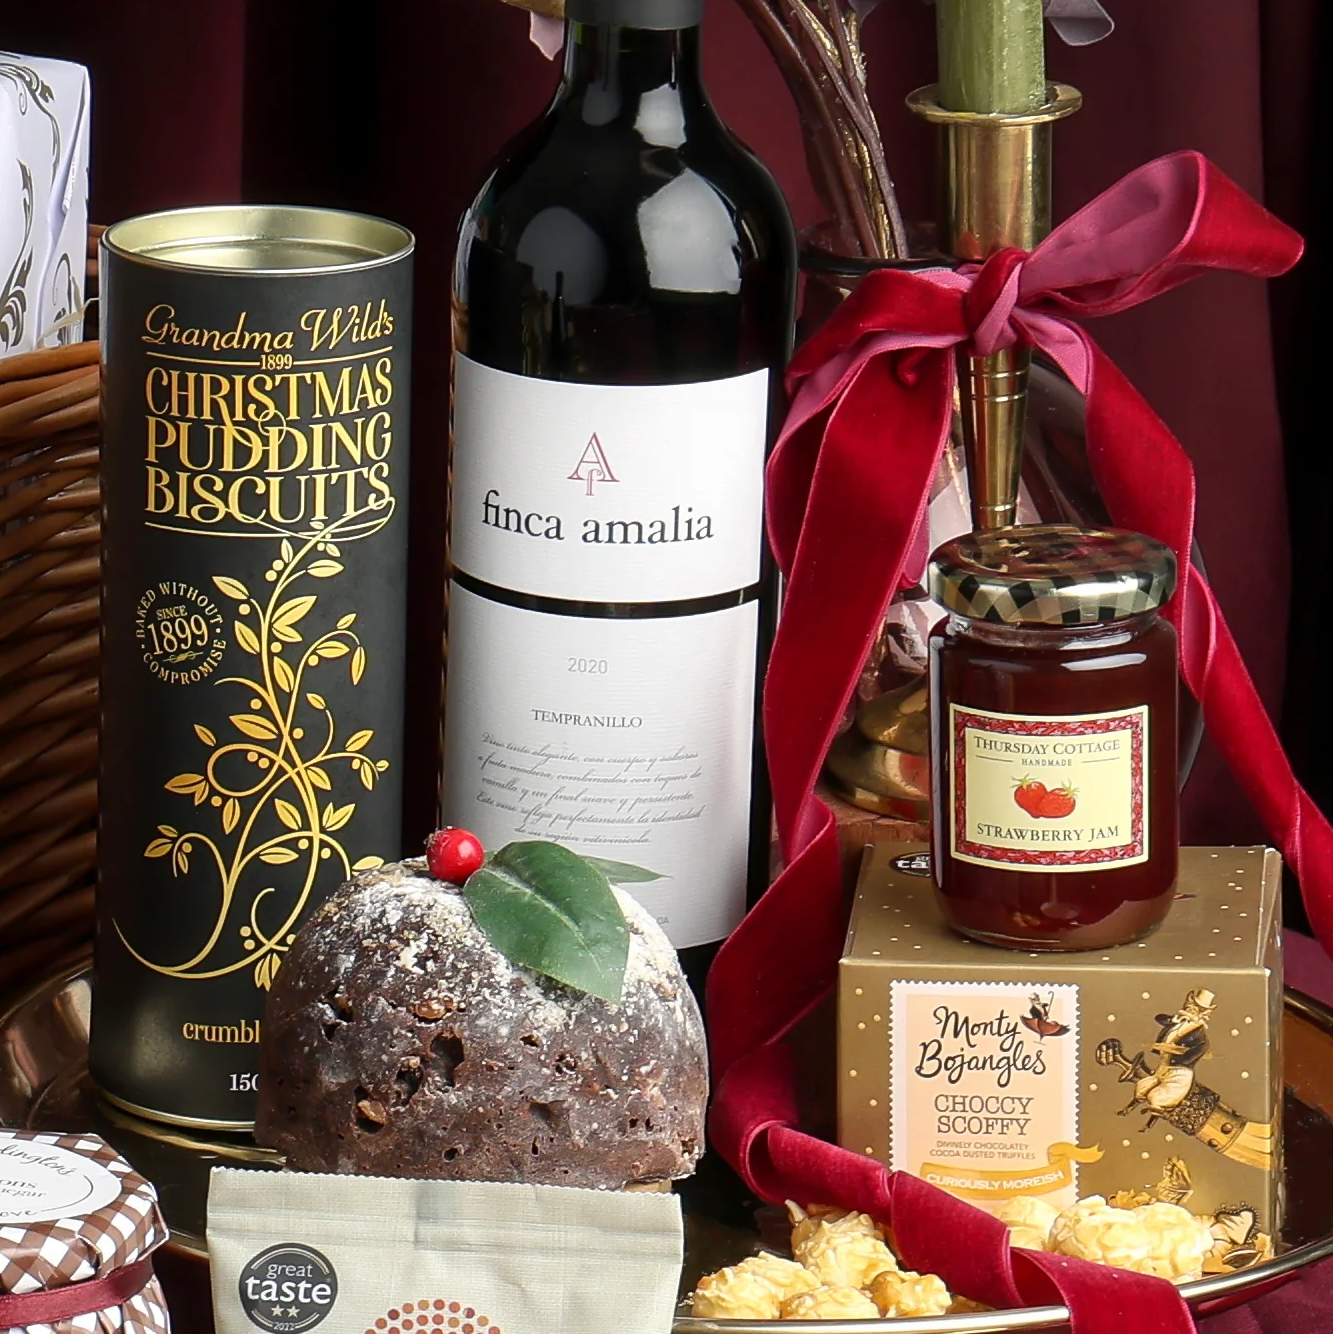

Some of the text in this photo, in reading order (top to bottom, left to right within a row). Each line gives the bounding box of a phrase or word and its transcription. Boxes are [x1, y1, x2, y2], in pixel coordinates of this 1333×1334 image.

[141, 299, 394, 353] Grandma Wild's
[260, 354, 293, 371] 1899
[145, 357, 392, 422] CHRISTMAS
[145, 411, 392, 472] PUDDING
[145, 462, 394, 524] BISCUITS
[482, 490, 714, 544] finca amalia
[567, 657, 608, 675] 2020
[532, 708, 643, 730] TEMPRANILLO
[973, 736, 1120, 755] THURSDAY COTTAGE
[976, 823, 1119, 842] STRAWBERRY JAM
[933, 1006, 1020, 1051] Monty
[915, 1039, 1047, 1088] Bojangles
[934, 1094, 1034, 1114] CHOCCY
[937, 1116, 1031, 1135] SCOFFY
[974, 1142, 1028, 1150] CHOCOLATEY
[926, 1171, 1064, 1190] CURIOUSLY MOREISH
[266, 1264, 312, 1279] great
[245, 1276, 331, 1304] taste
